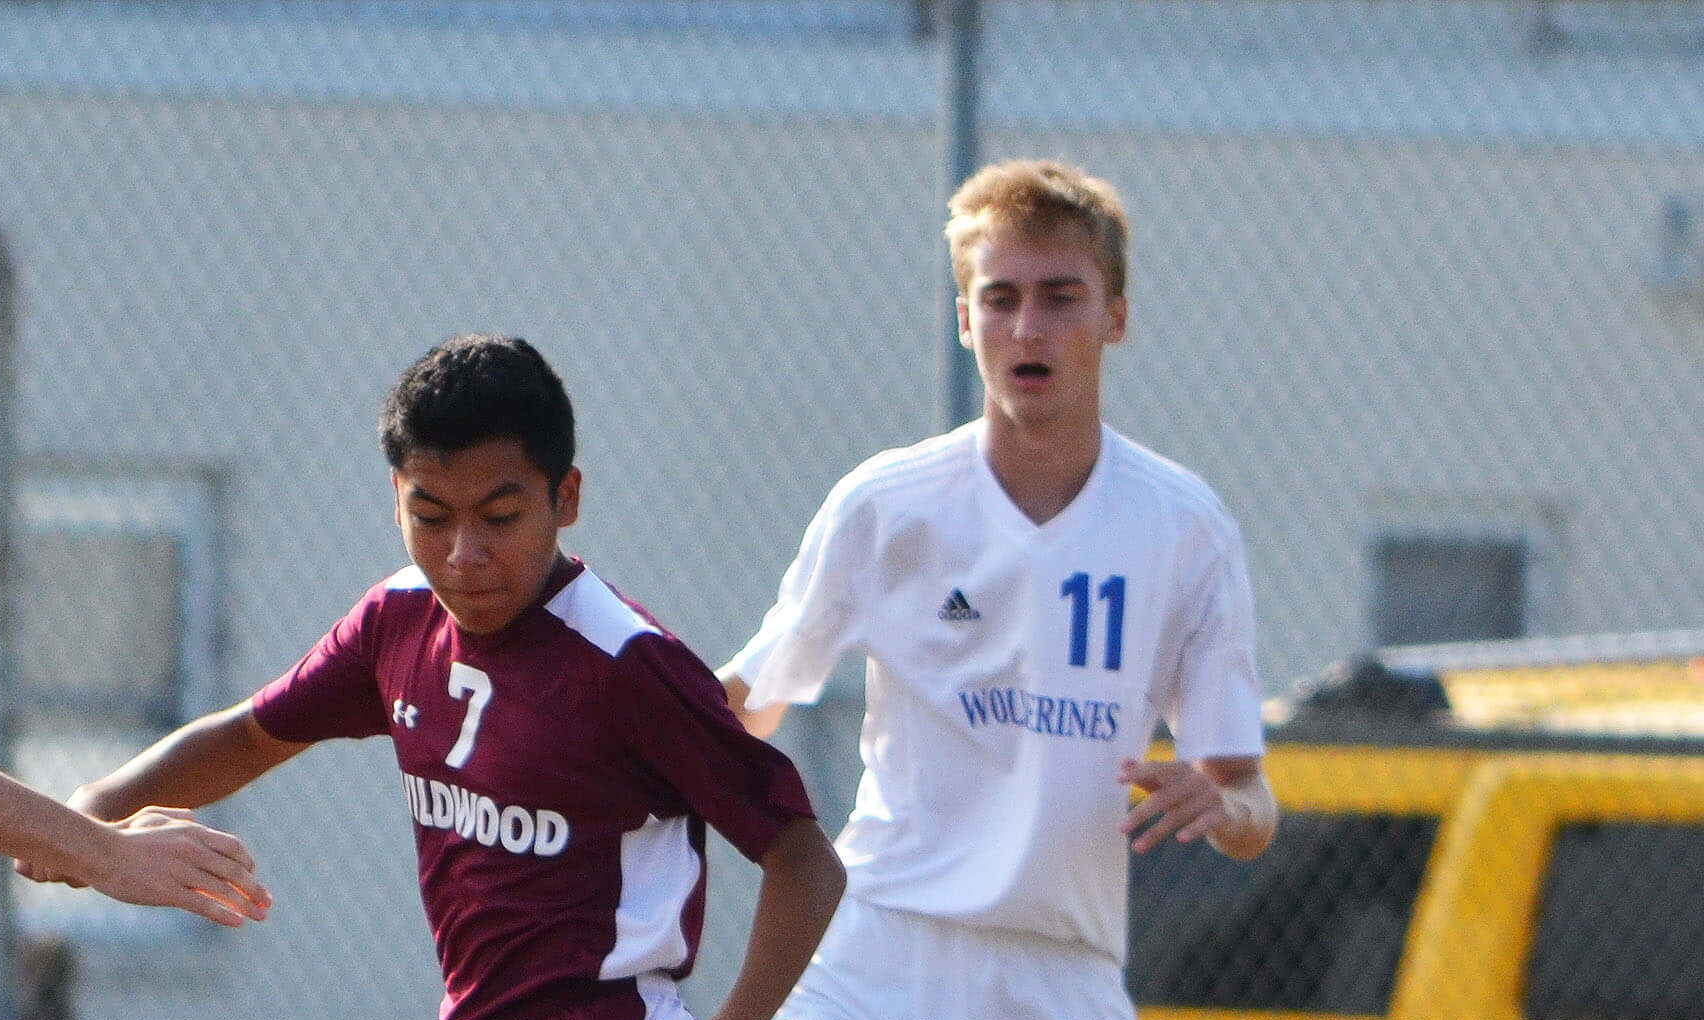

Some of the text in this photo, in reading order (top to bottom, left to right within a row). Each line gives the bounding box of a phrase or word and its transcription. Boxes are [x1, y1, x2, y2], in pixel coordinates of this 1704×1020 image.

[1061, 571, 1126, 671] 11
[445, 661, 492, 769] 7
[958, 687, 1121, 741] WOLERINES
